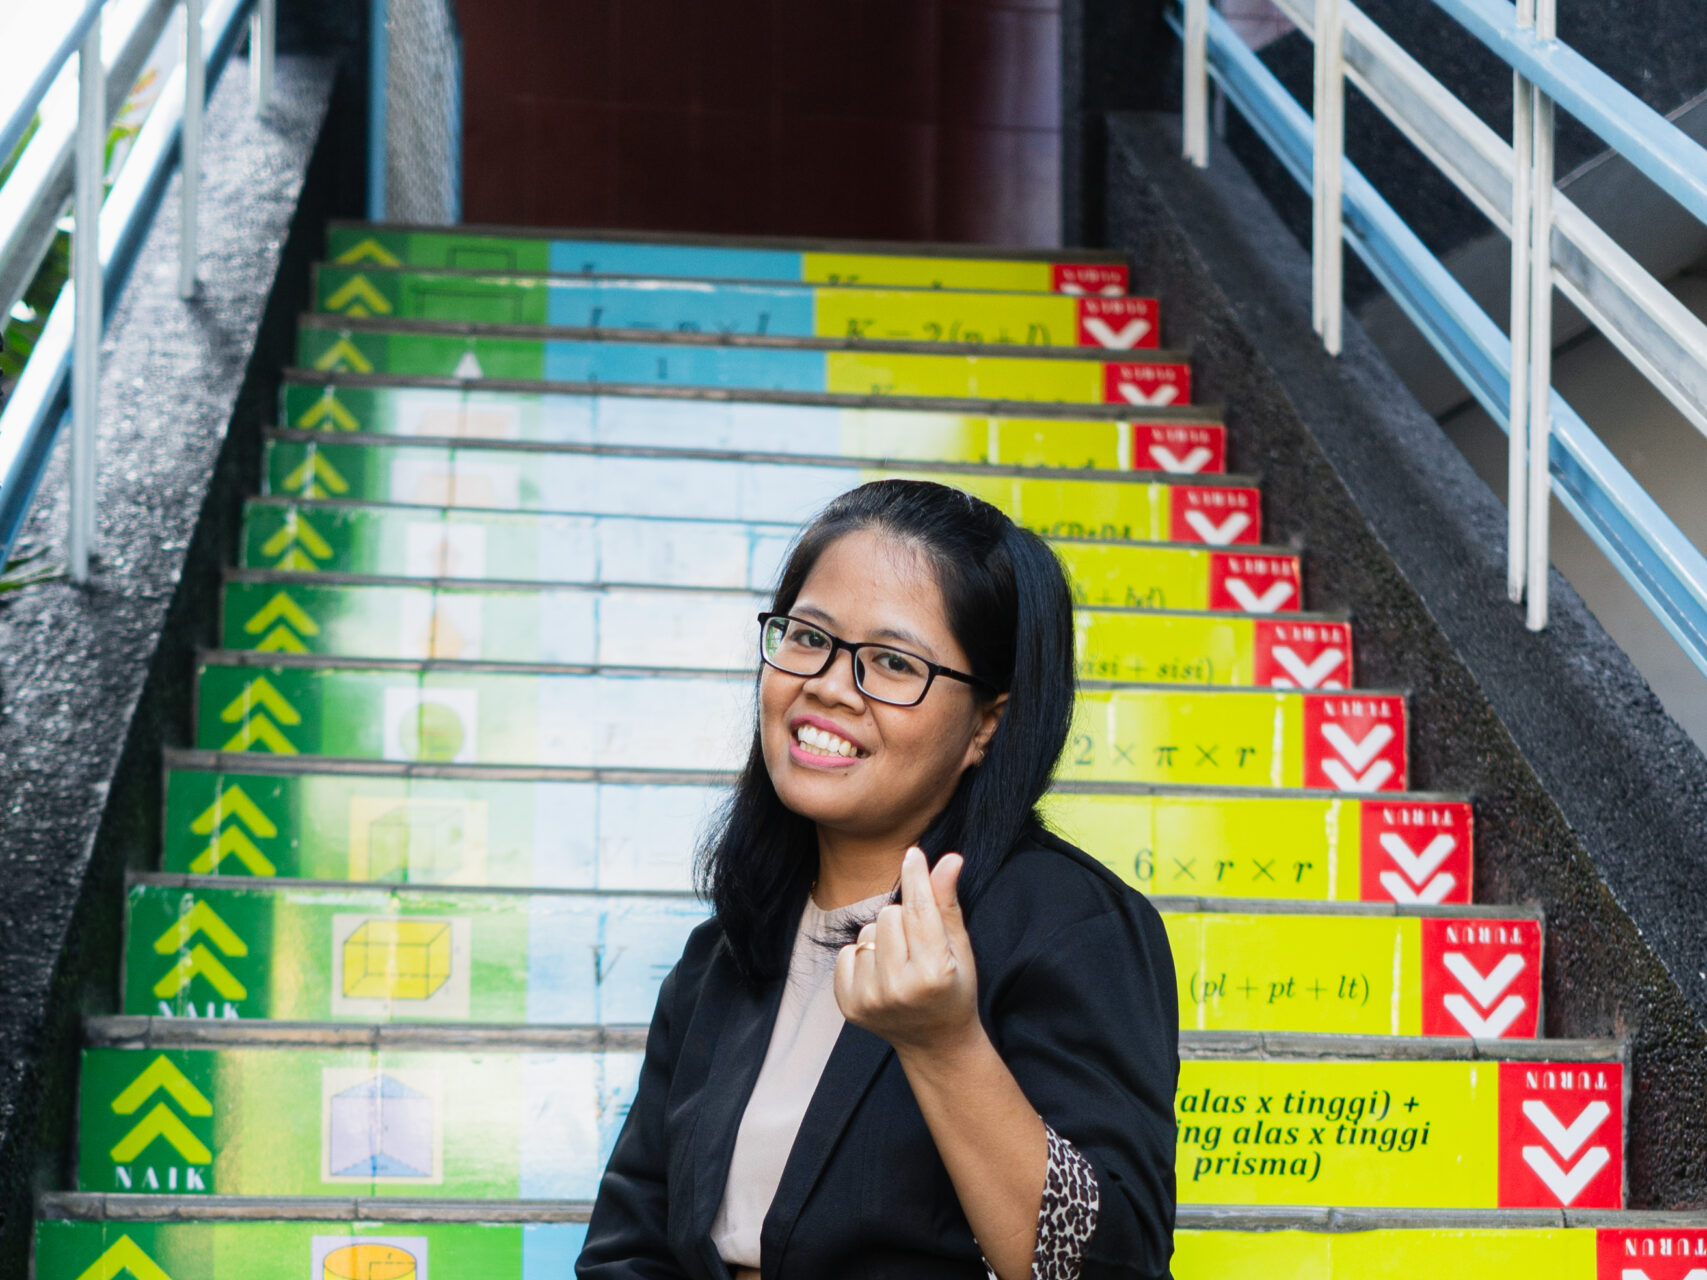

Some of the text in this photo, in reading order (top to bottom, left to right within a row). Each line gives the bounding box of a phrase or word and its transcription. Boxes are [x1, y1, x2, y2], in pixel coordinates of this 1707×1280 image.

[1074, 735, 1093, 765] 2
[1238, 746, 1256, 768] r
[1134, 848, 1154, 882] 6
[1215, 859, 1234, 882] r
[1294, 860, 1313, 883] r
[1267, 976, 1296, 1005] pt
[1526, 1070, 1608, 1090] TURUN
[1178, 1087, 1248, 1114] alas
[1255, 1094, 1274, 1114] x
[1282, 1089, 1391, 1122] tinggi)
[1232, 1119, 1300, 1145] alas
[1307, 1126, 1326, 1146] x
[1335, 1121, 1431, 1153] tinggi
[114, 1165, 206, 1191] NAIK
[1192, 1151, 1321, 1183] prisma)
[1624, 1237, 1707, 1257] TURUN
